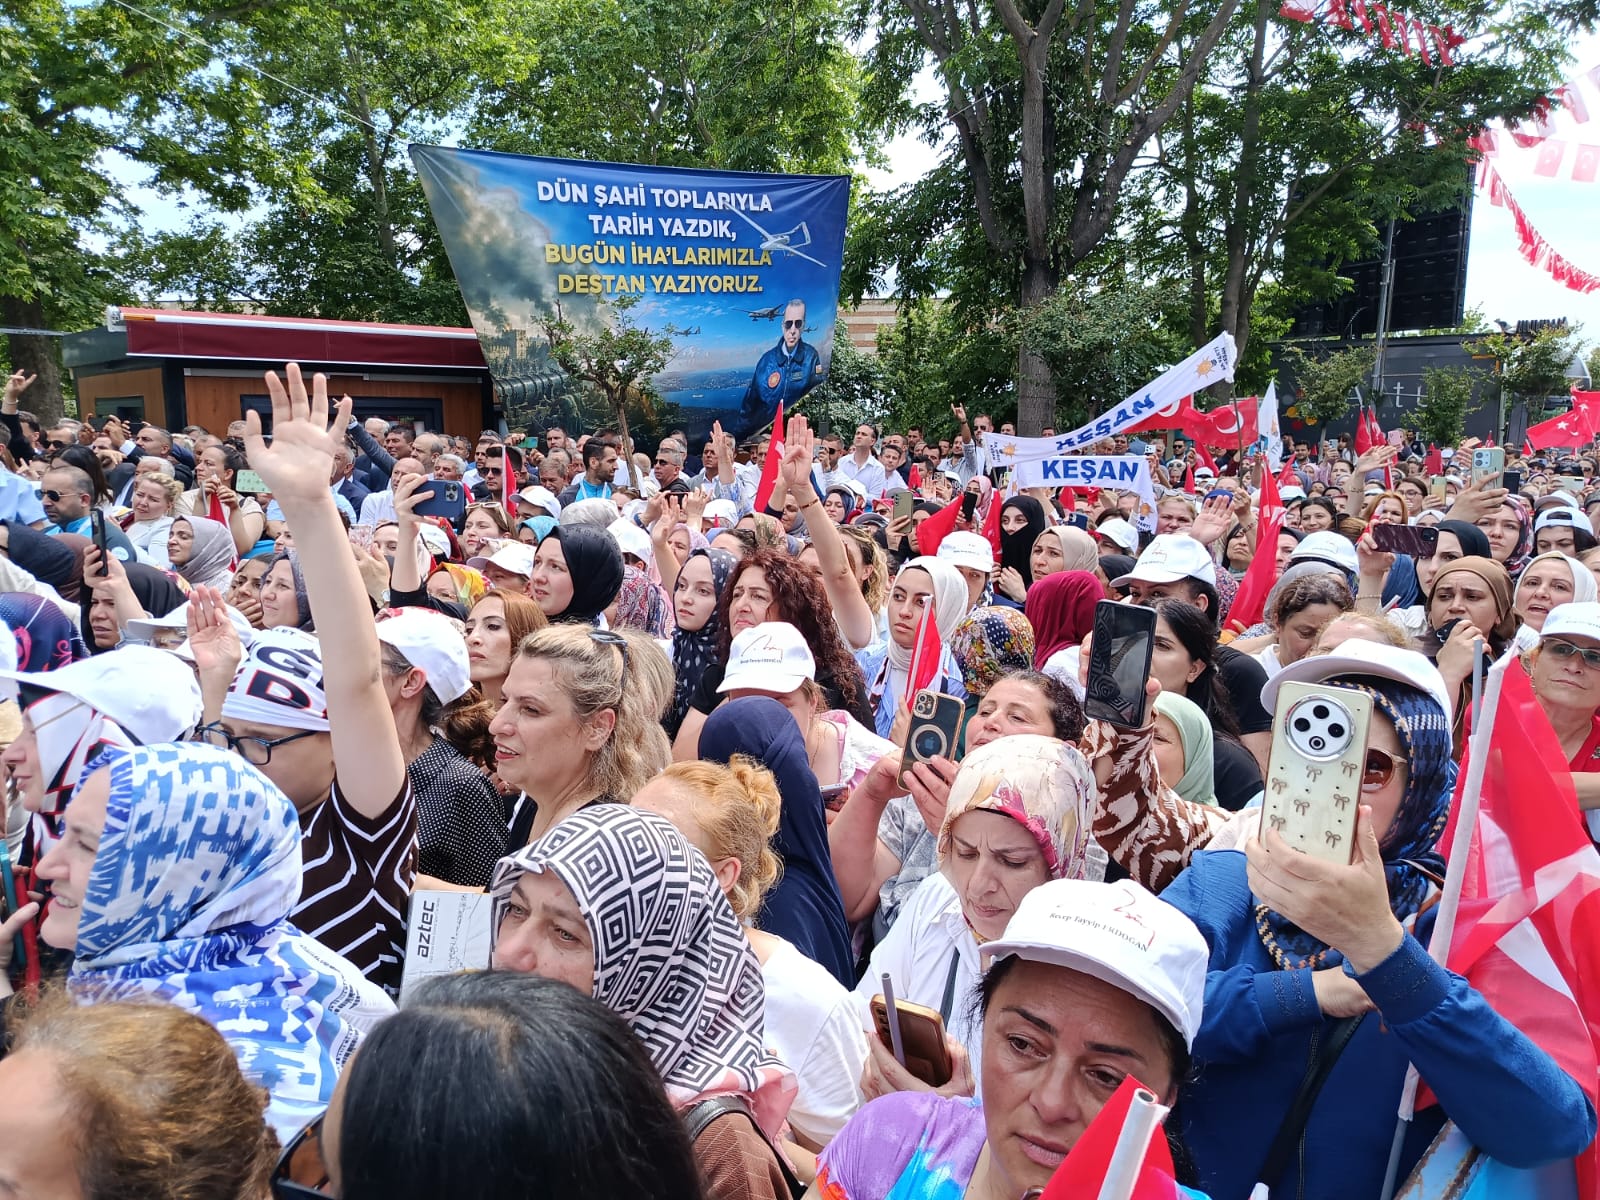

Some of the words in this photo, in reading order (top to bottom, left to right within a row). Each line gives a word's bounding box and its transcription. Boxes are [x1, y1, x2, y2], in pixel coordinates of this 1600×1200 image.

[537, 178, 588, 204] DÜN
[593, 182, 647, 210] ŞAHİ
[651, 187, 773, 213] TOPLARIYLA
[588, 211, 654, 237] TARİH
[658, 217, 737, 243] YAZDIK,
[544, 240, 627, 265] BUGÜN
[631, 241, 773, 267] İHA'LARIMIZLA
[558, 273, 646, 295] DESTAN
[650, 274, 764, 295] YAZIYORUZ.
[1056, 393, 1155, 453] KEŞAN
[1042, 459, 1139, 484] KEŞAN
[416, 900, 435, 958] aztec
